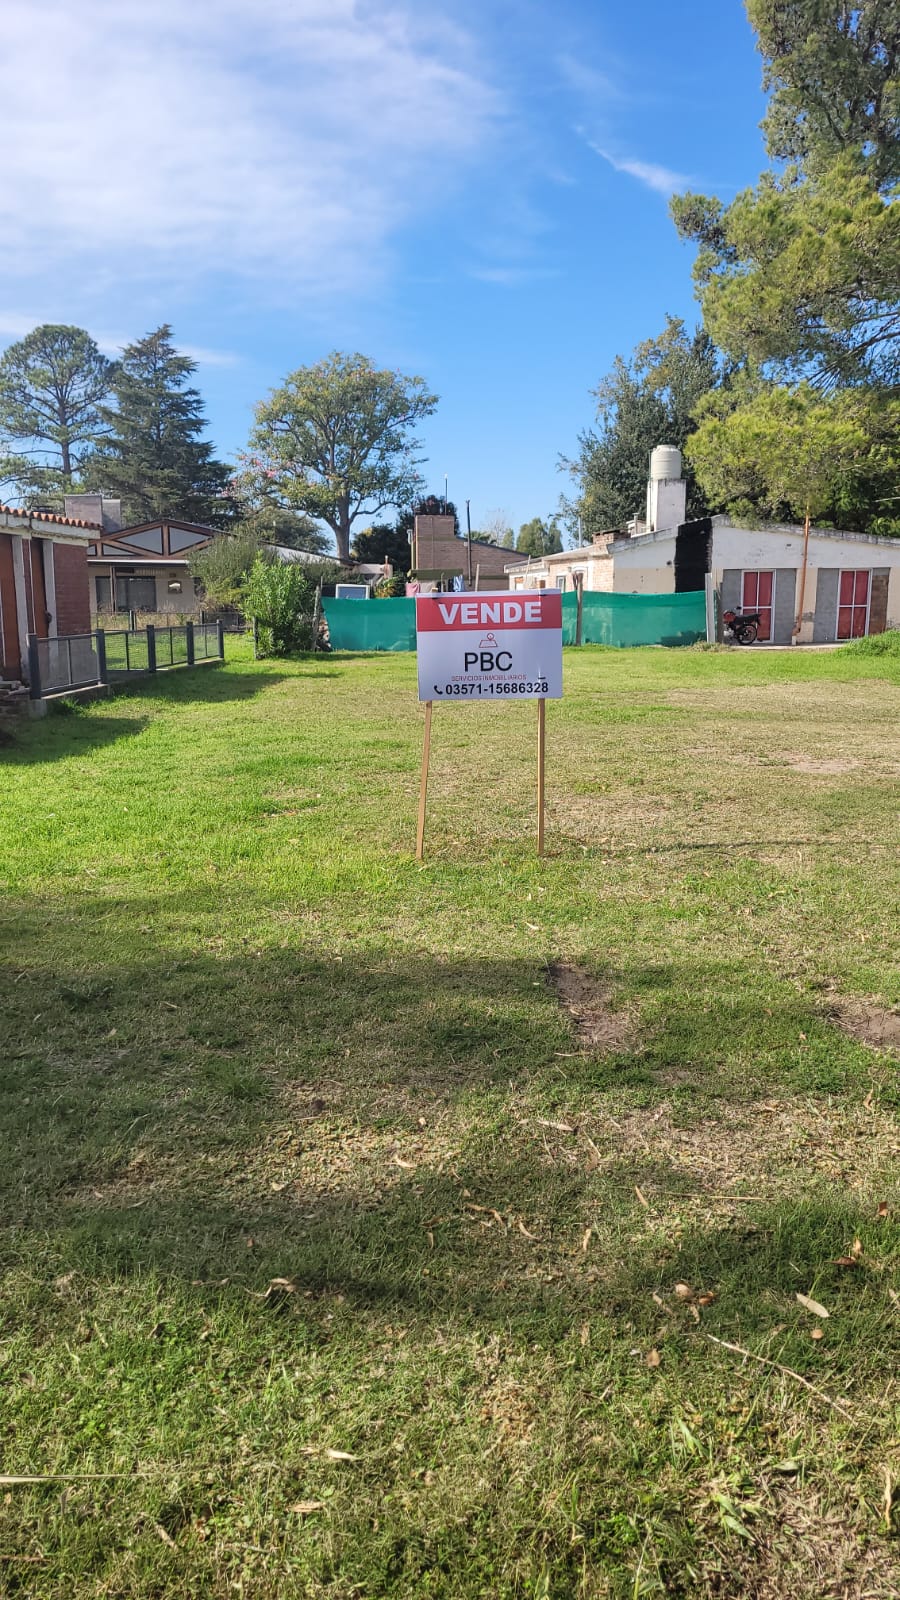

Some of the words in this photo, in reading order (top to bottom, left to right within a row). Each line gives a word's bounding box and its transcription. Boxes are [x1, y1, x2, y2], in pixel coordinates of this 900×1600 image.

[438, 601, 542, 625] VENDE
[464, 651, 513, 672] PBC
[445, 682, 549, 695] 03571-15686328
